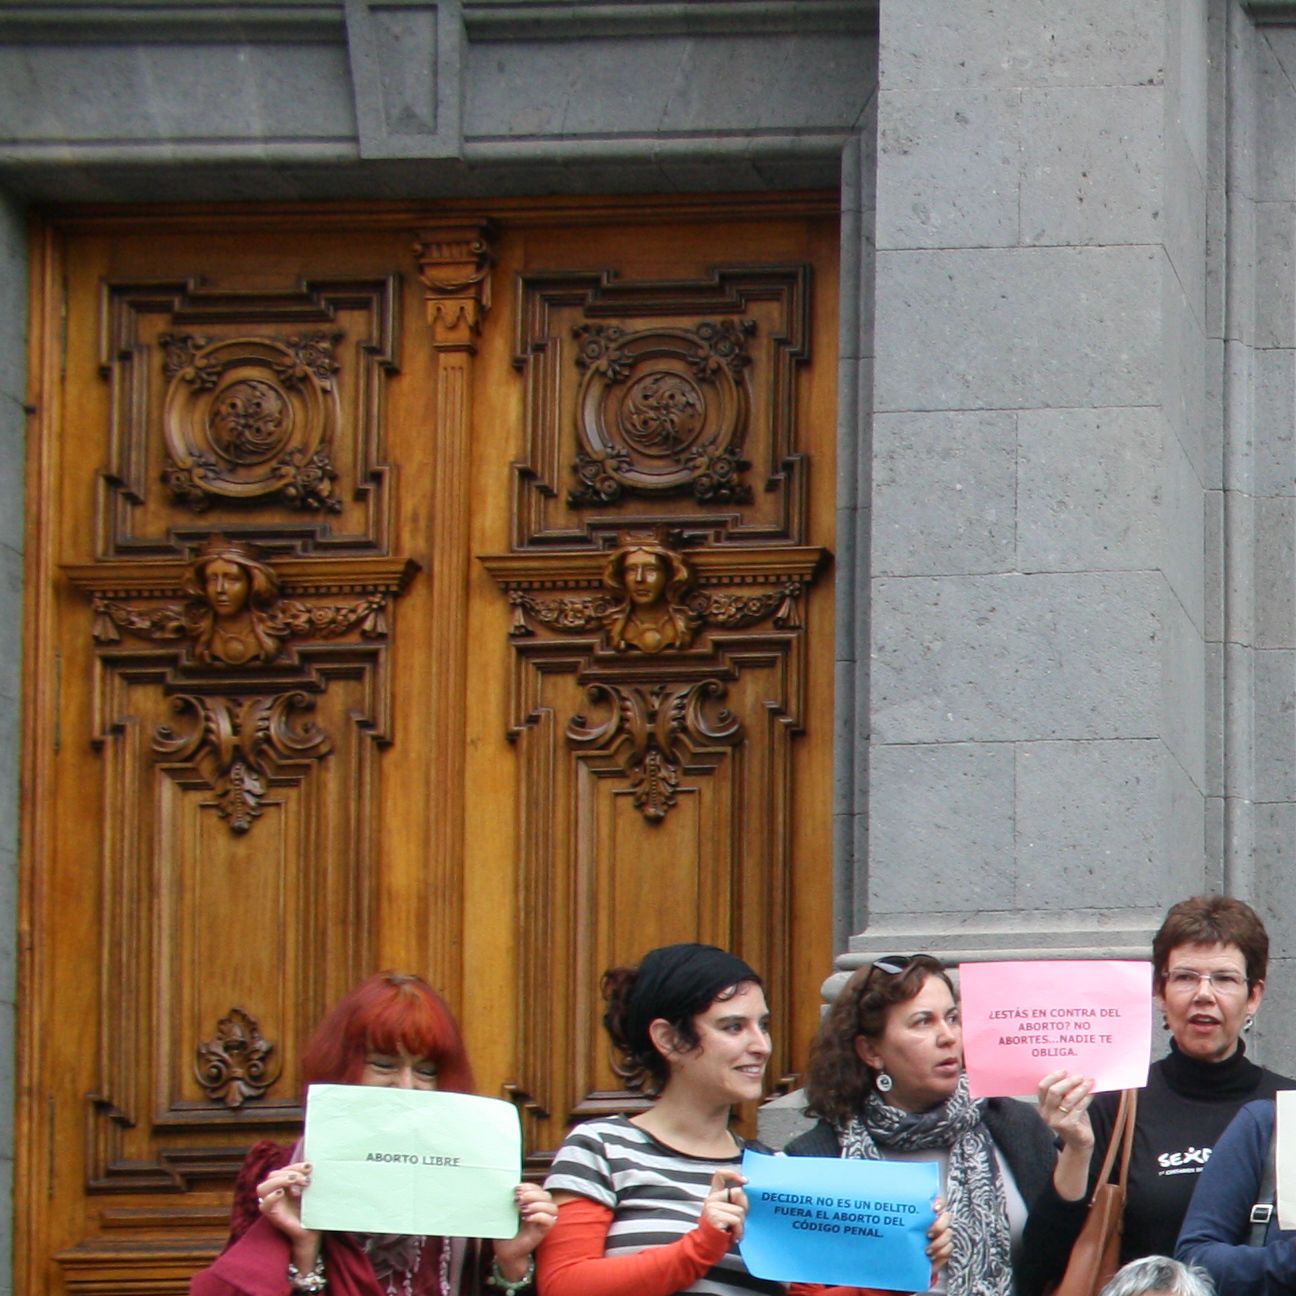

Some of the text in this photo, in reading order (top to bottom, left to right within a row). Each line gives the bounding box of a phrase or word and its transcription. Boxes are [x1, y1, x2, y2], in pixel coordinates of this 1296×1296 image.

[989, 1009, 1120, 1019] ¿ESTÁS EN CONTRA DEL
[1019, 1022, 1090, 1031] ABORTO? NO
[1099, 1035, 1112, 1043] TE
[366, 1153, 460, 1167] ABORTO LIBRE
[762, 1192, 919, 1214] DECIDIR NO ES UN DELITO.
[774, 1206, 904, 1226] FUERA EL ABORTO DEL
[792, 1220, 884, 1237] CÓDIGO PENAL.
